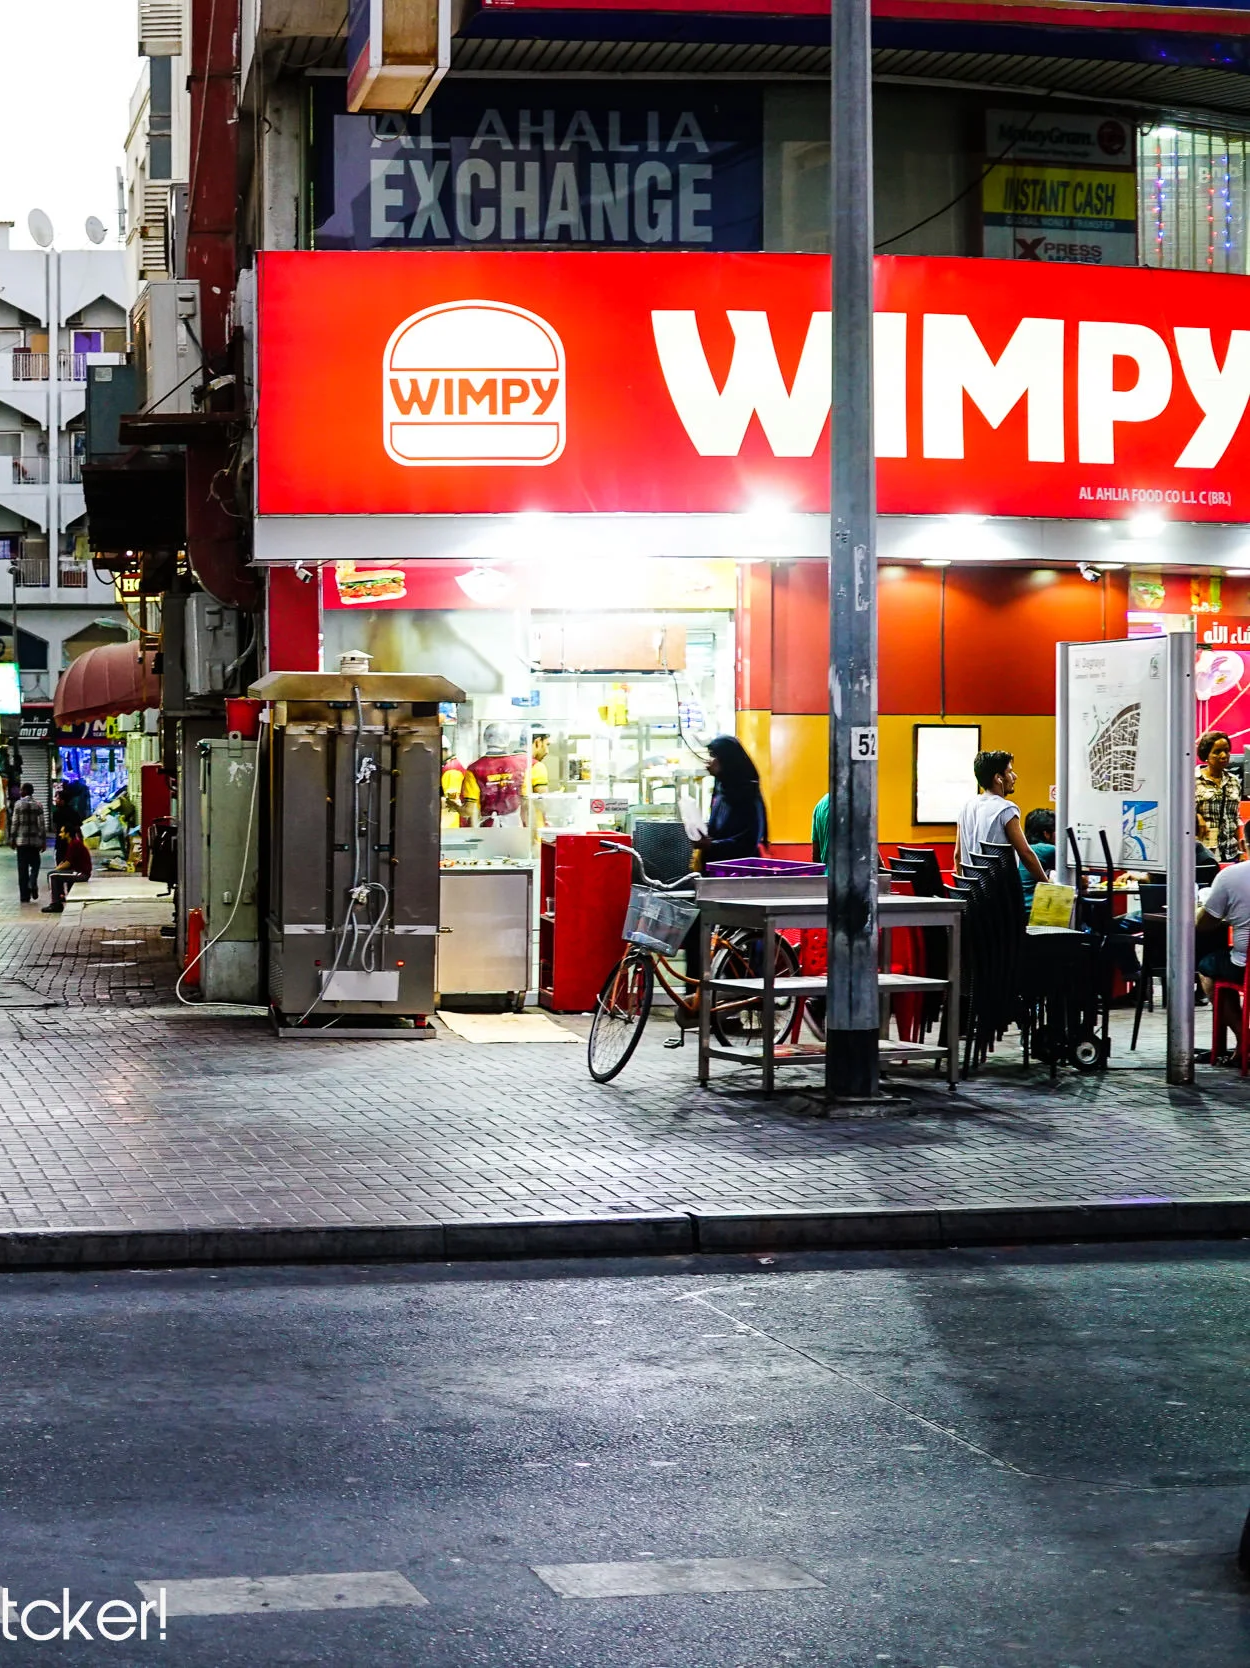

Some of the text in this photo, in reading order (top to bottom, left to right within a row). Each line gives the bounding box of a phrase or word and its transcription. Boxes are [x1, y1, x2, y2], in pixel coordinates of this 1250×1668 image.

[370, 108, 710, 152] AL AHALIA
[370, 158, 713, 242] EXCHANGE
[1004, 178, 1116, 216] INSTANT CASH
[1073, 219, 1116, 230] TRANSFER
[389, 378, 560, 416] WIMPY
[651, 309, 1250, 469] WIMPY
[1079, 487, 1095, 500] AL
[1096, 487, 1130, 501] AHLIA
[1131, 489, 1163, 502] FOOD
[1165, 490, 1180, 503] CO
[1204, 621, 1229, 644] الله
